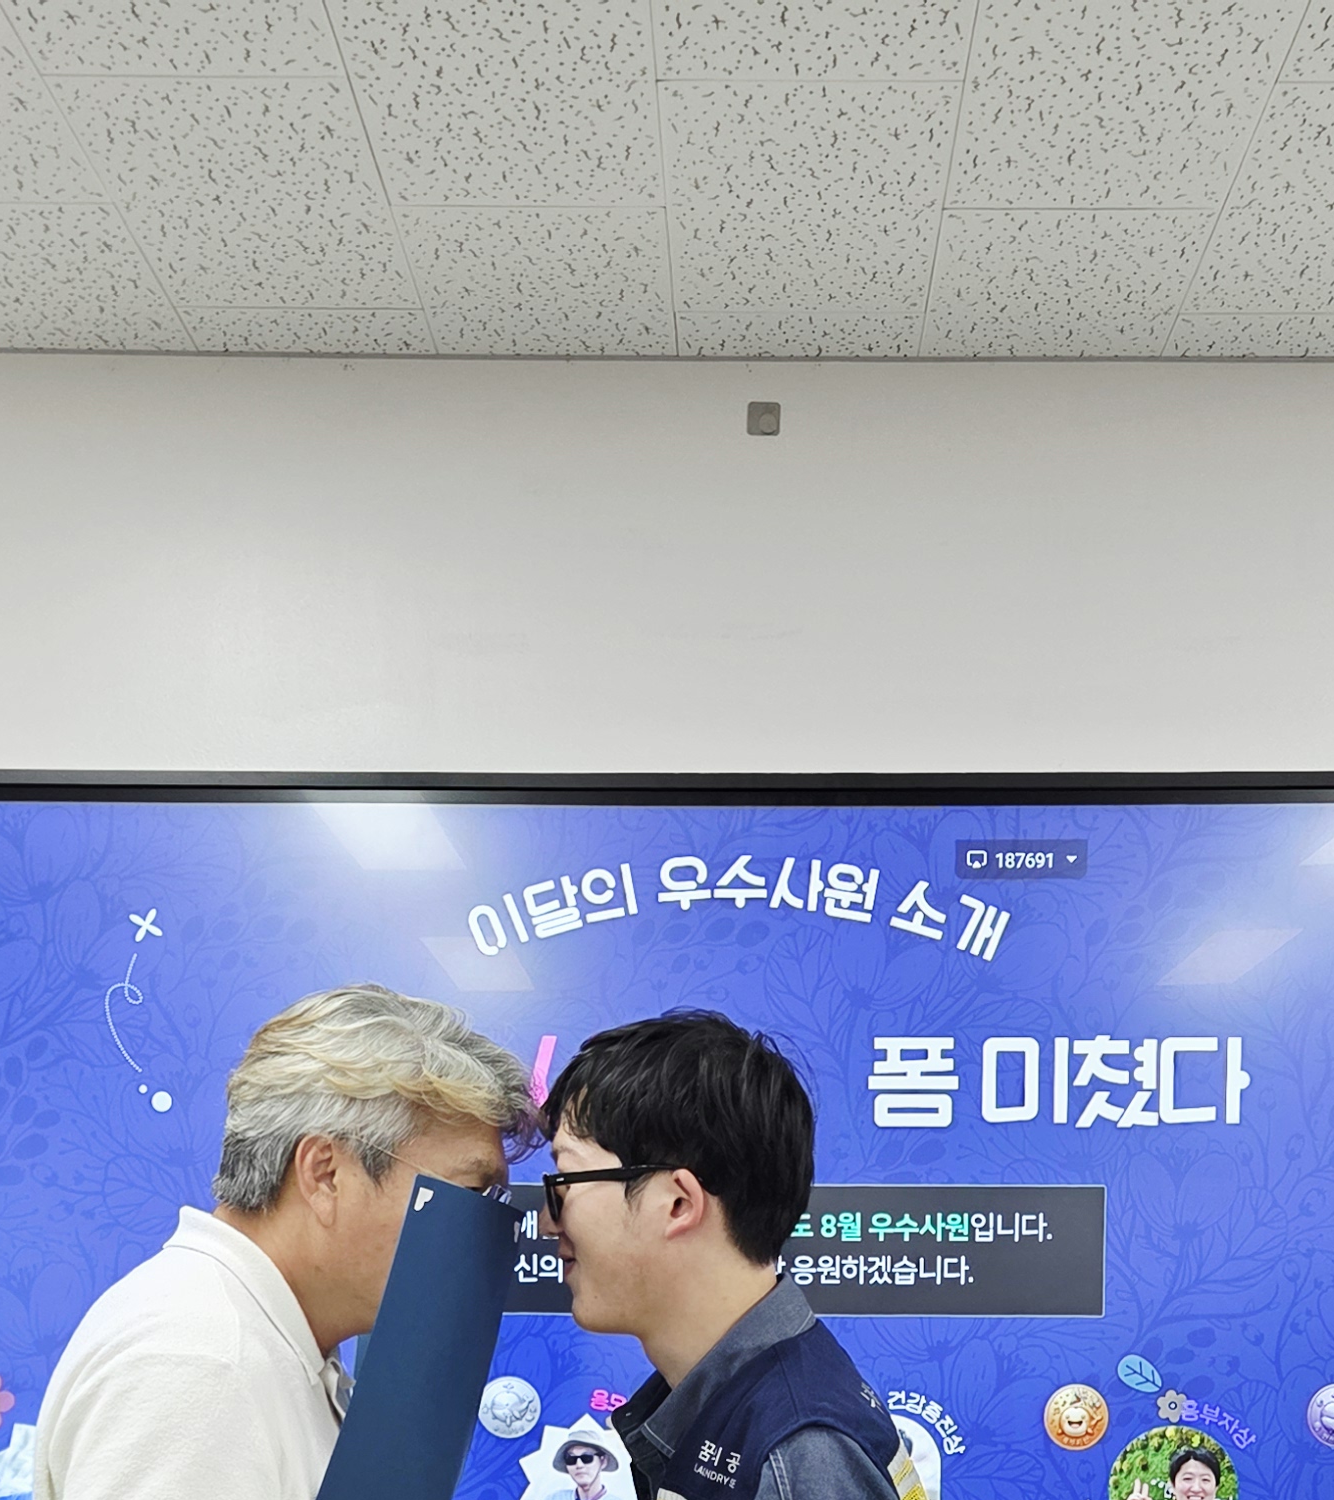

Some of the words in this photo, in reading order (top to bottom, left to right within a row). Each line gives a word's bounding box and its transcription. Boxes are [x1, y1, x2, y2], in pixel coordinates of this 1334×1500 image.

[995, 852, 1055, 869] 187691
[467, 862, 639, 957] 이달의
[657, 854, 882, 922] 우수사원
[890, 880, 1012, 962] 소개
[868, 1036, 960, 1129] 폼
[981, 1034, 1252, 1129] 미쳤다
[820, 1211, 862, 1243] 8월
[868, 1211, 1054, 1244] 우수사원입니다.
[790, 1254, 975, 1286] 응원하겠습니다.
[887, 1390, 966, 1455] 건강증진상
